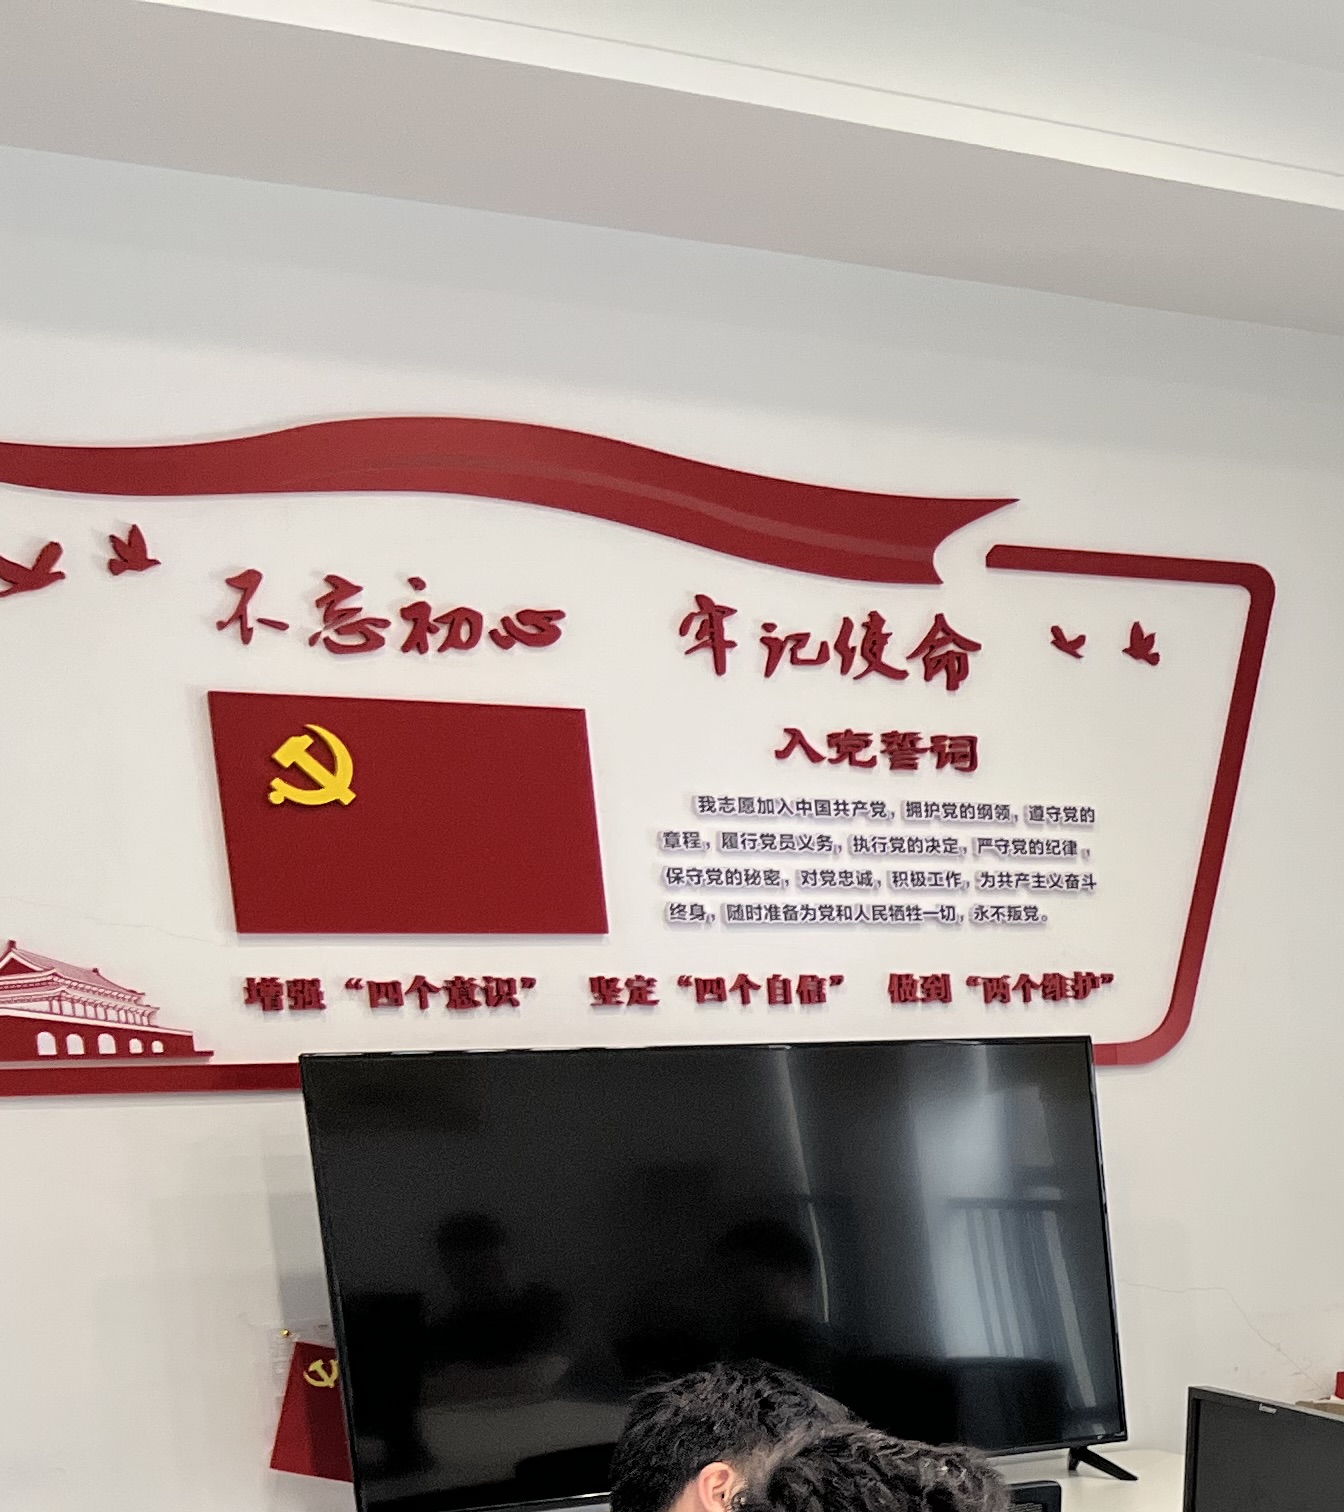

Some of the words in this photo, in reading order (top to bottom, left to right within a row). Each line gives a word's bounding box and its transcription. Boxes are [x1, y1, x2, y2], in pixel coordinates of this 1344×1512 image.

[216, 568, 567, 654] 不忘初心
[678, 593, 983, 692] 牢记使命
[774, 727, 978, 772] 入党誓词
